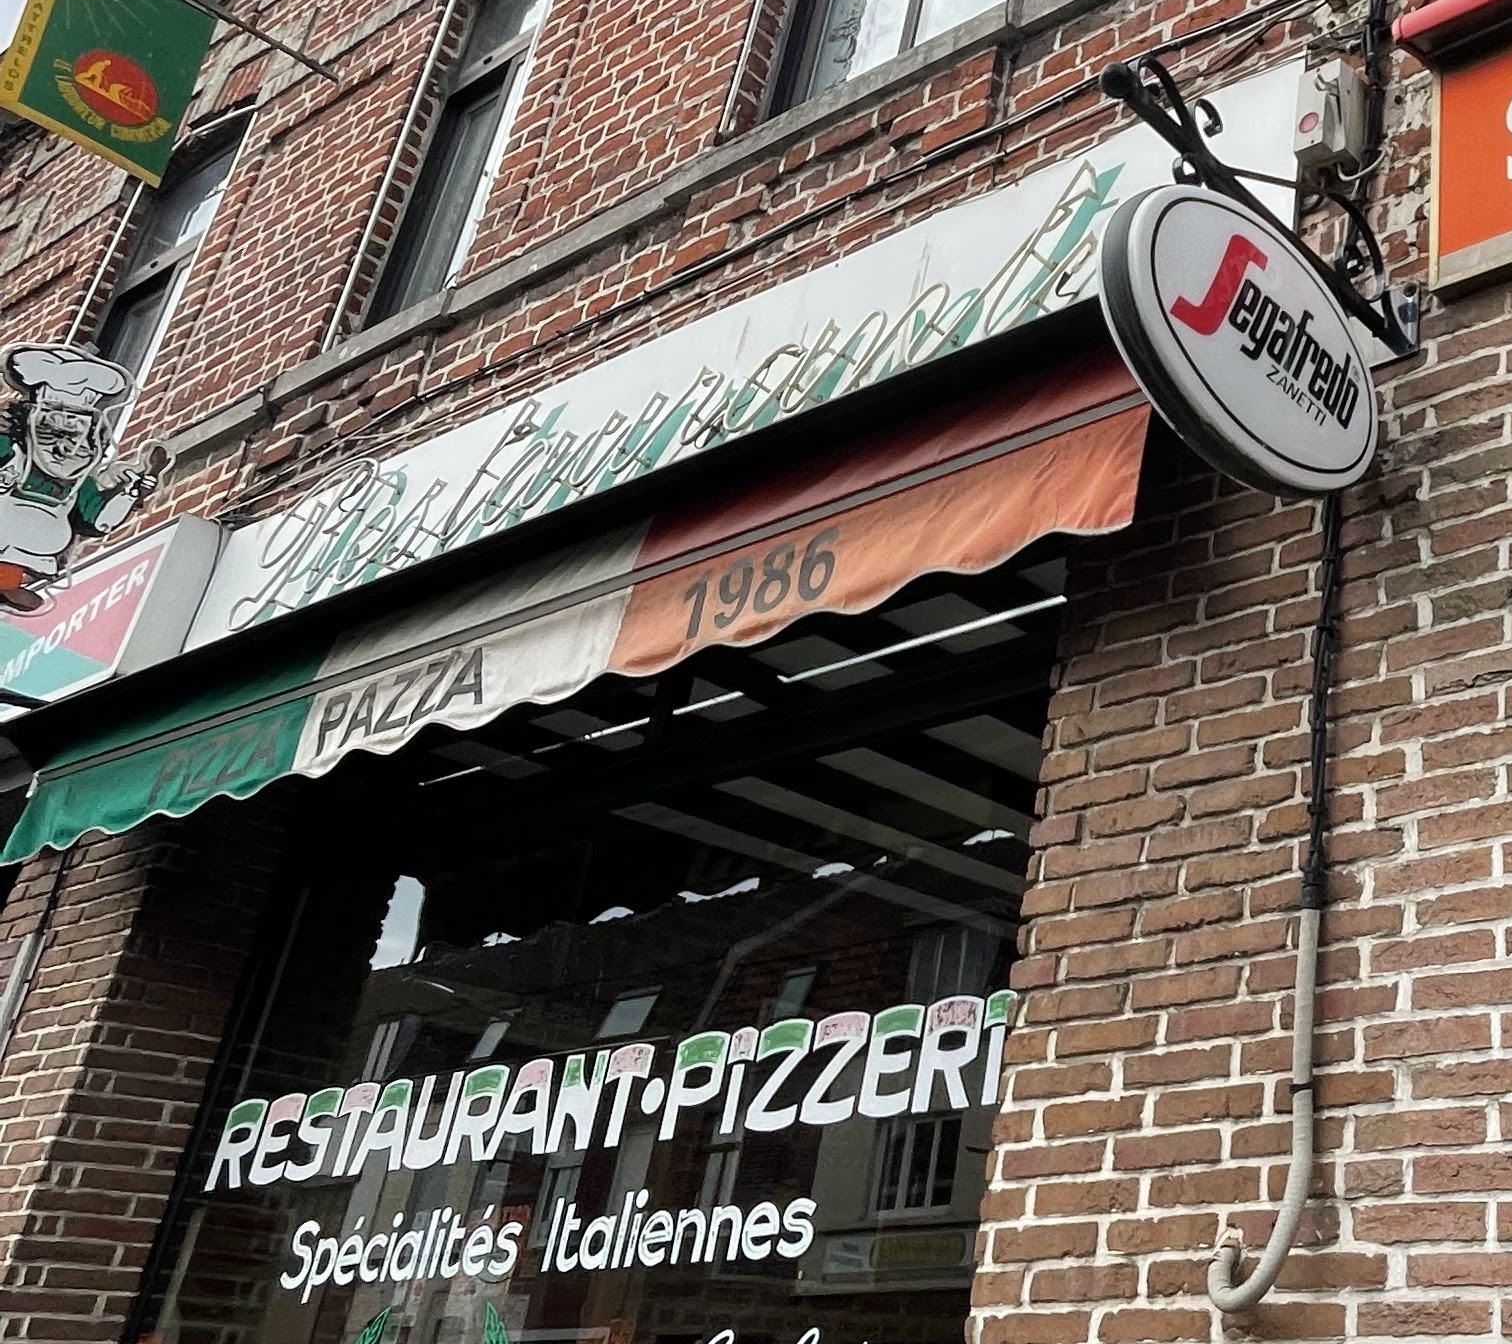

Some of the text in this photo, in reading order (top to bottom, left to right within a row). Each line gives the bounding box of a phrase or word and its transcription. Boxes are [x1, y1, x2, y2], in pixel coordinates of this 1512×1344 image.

[1170, 234, 1361, 430] Segafredo
[1266, 365, 1328, 427] ZANETTI
[0, 558, 150, 684] MPORTER
[683, 527, 842, 642] 1986
[317, 646, 486, 760] PAZZA
[148, 716, 284, 806] PIZZA
[280, 1188, 819, 1306] Spécialités Italiennes
